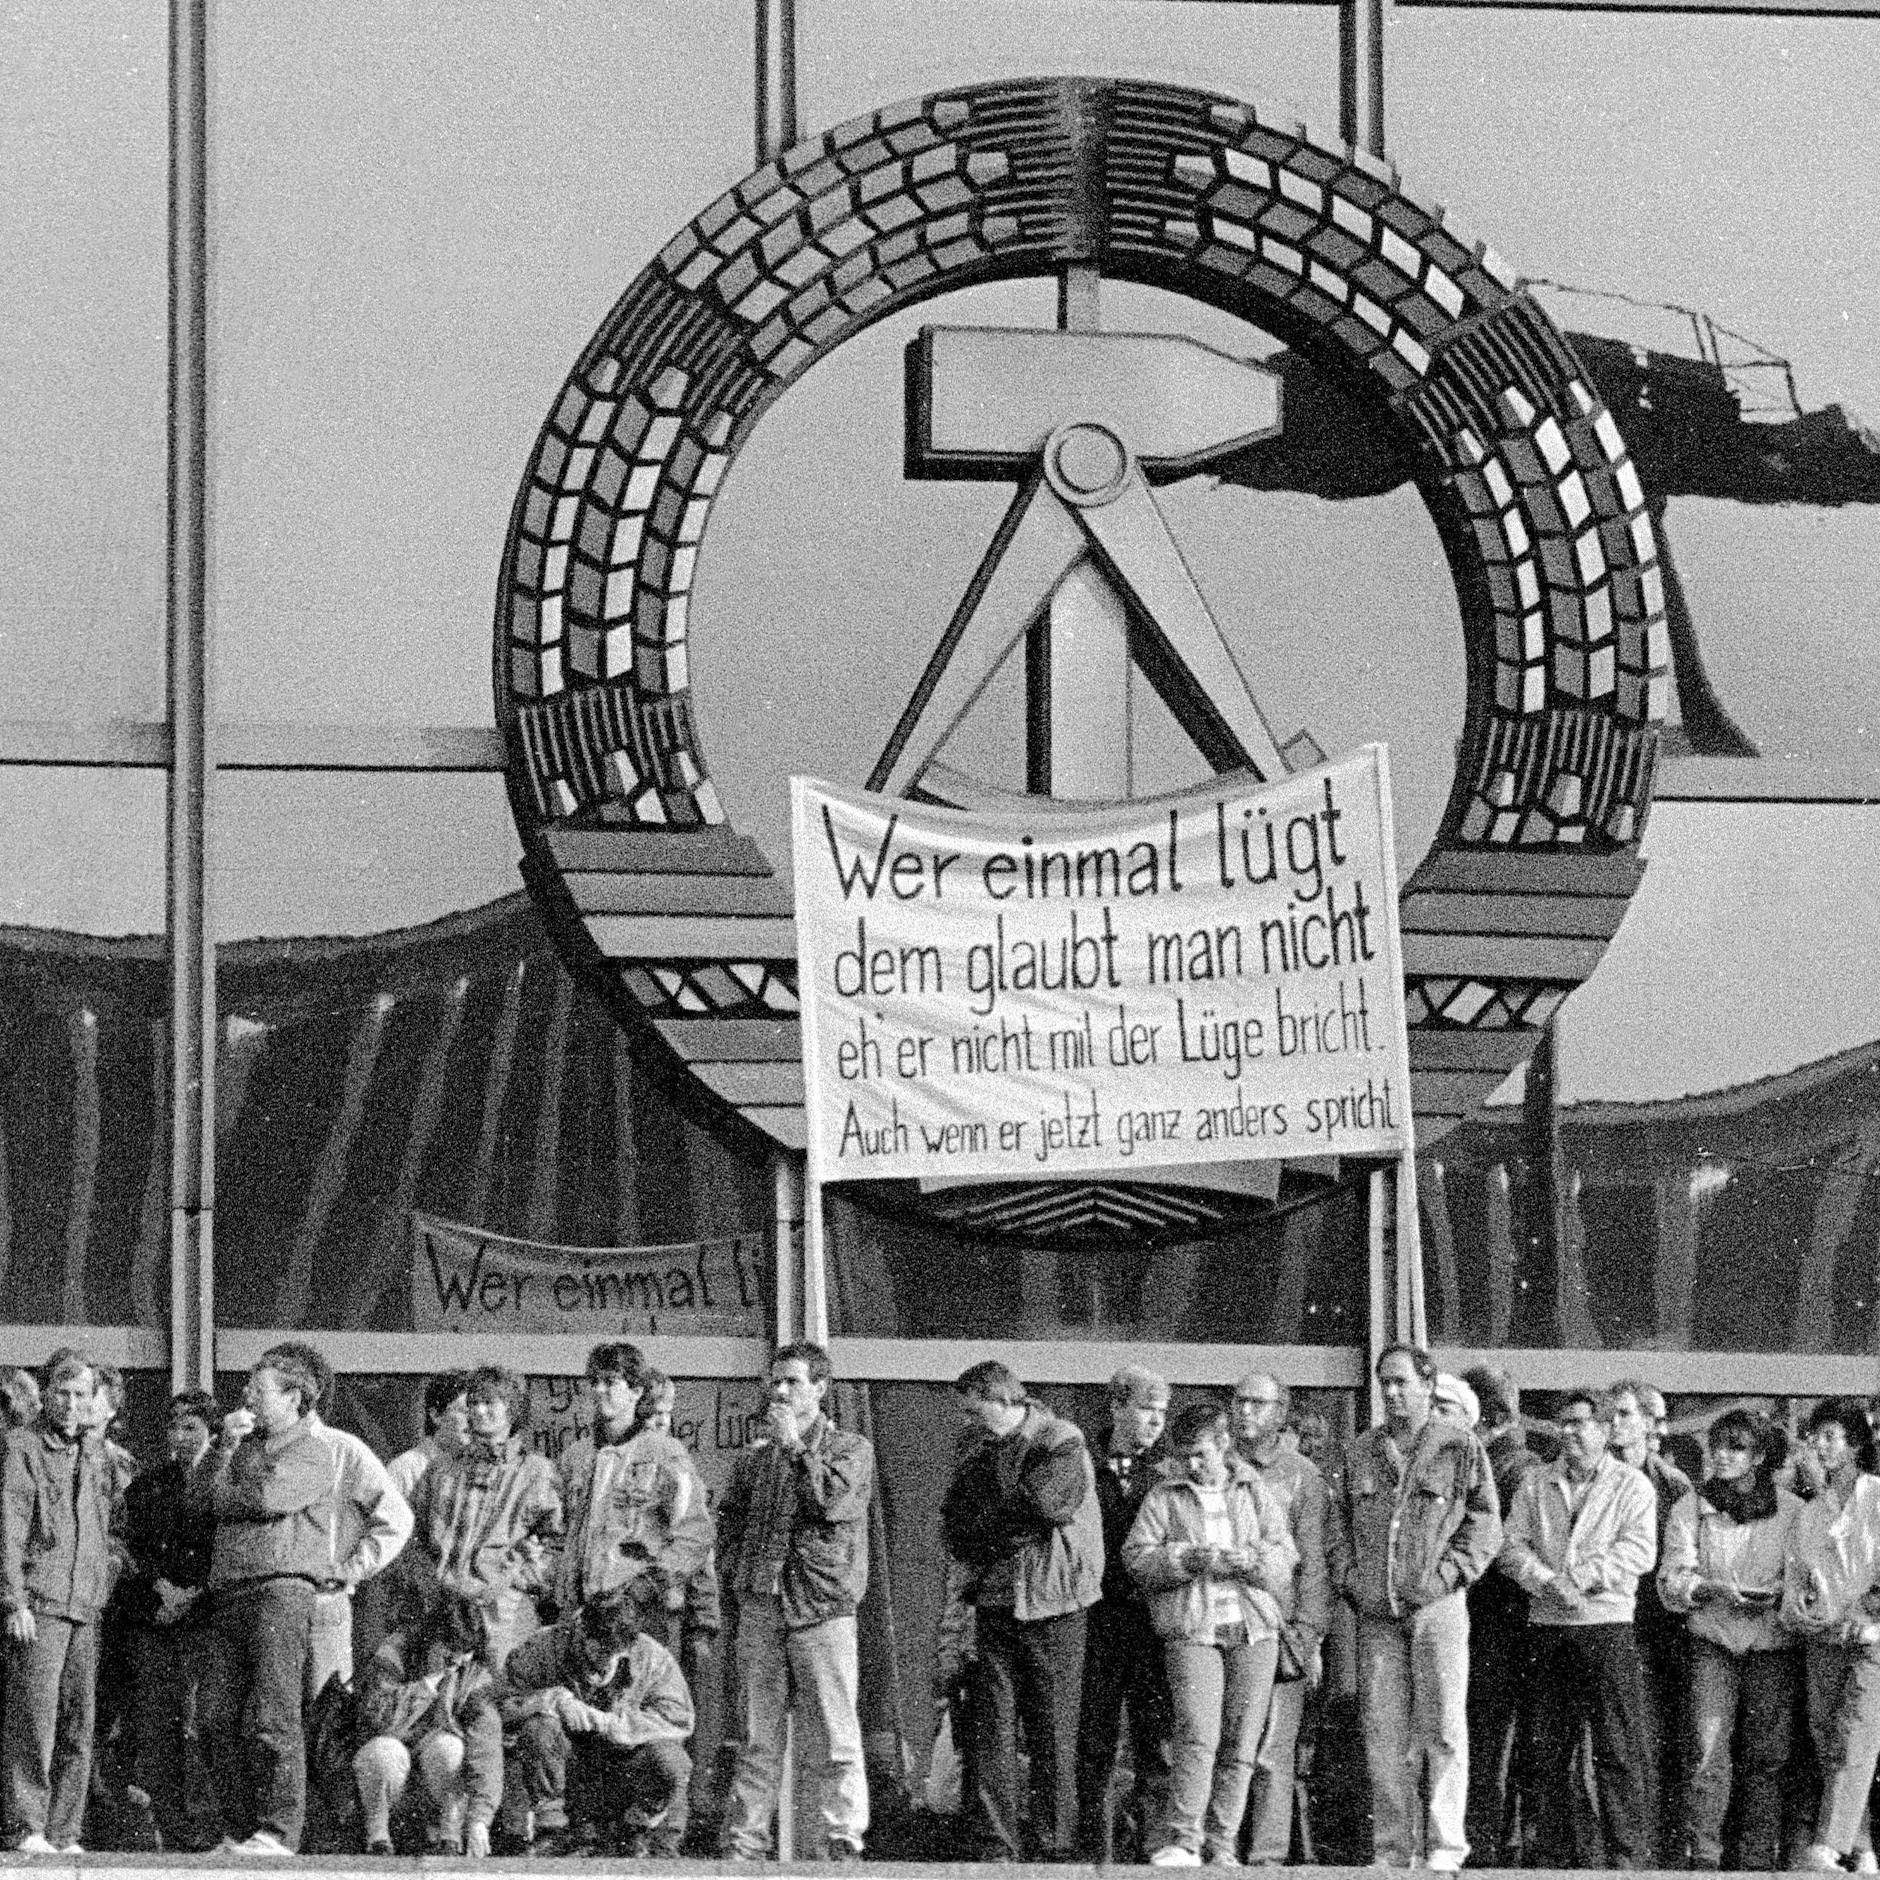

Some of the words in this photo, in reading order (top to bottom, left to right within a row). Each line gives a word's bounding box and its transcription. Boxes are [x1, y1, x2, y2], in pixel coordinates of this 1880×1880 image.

[822, 803, 962, 900] Wer
[982, 809, 1183, 900] einmal
[1217, 777, 1346, 902] lügt
[834, 915, 943, 998] dem
[967, 905, 1121, 1016] glaubt
[1148, 924, 1243, 984] man
[1259, 880, 1375, 975] nicht
[897, 1036, 943, 1078] er
[952, 1013, 1050, 1074] nicht
[1109, 1004, 1162, 1067] der
[1177, 998, 1263, 1080] Lüge
[1275, 978, 1386, 1057] bricht.
[838, 1094, 910, 1158] Auch
[920, 1121, 989, 1154] wenn
[1000, 1120, 1038, 1151] er
[1034, 1087, 1112, 1162] jetzt
[1117, 1109, 1182, 1156] ganz
[1196, 1083, 1288, 1141] anders
[1306, 1077, 1400, 1141] spricht
[425, 1232, 534, 1314] Wer
[553, 1243, 714, 1311] einmal
